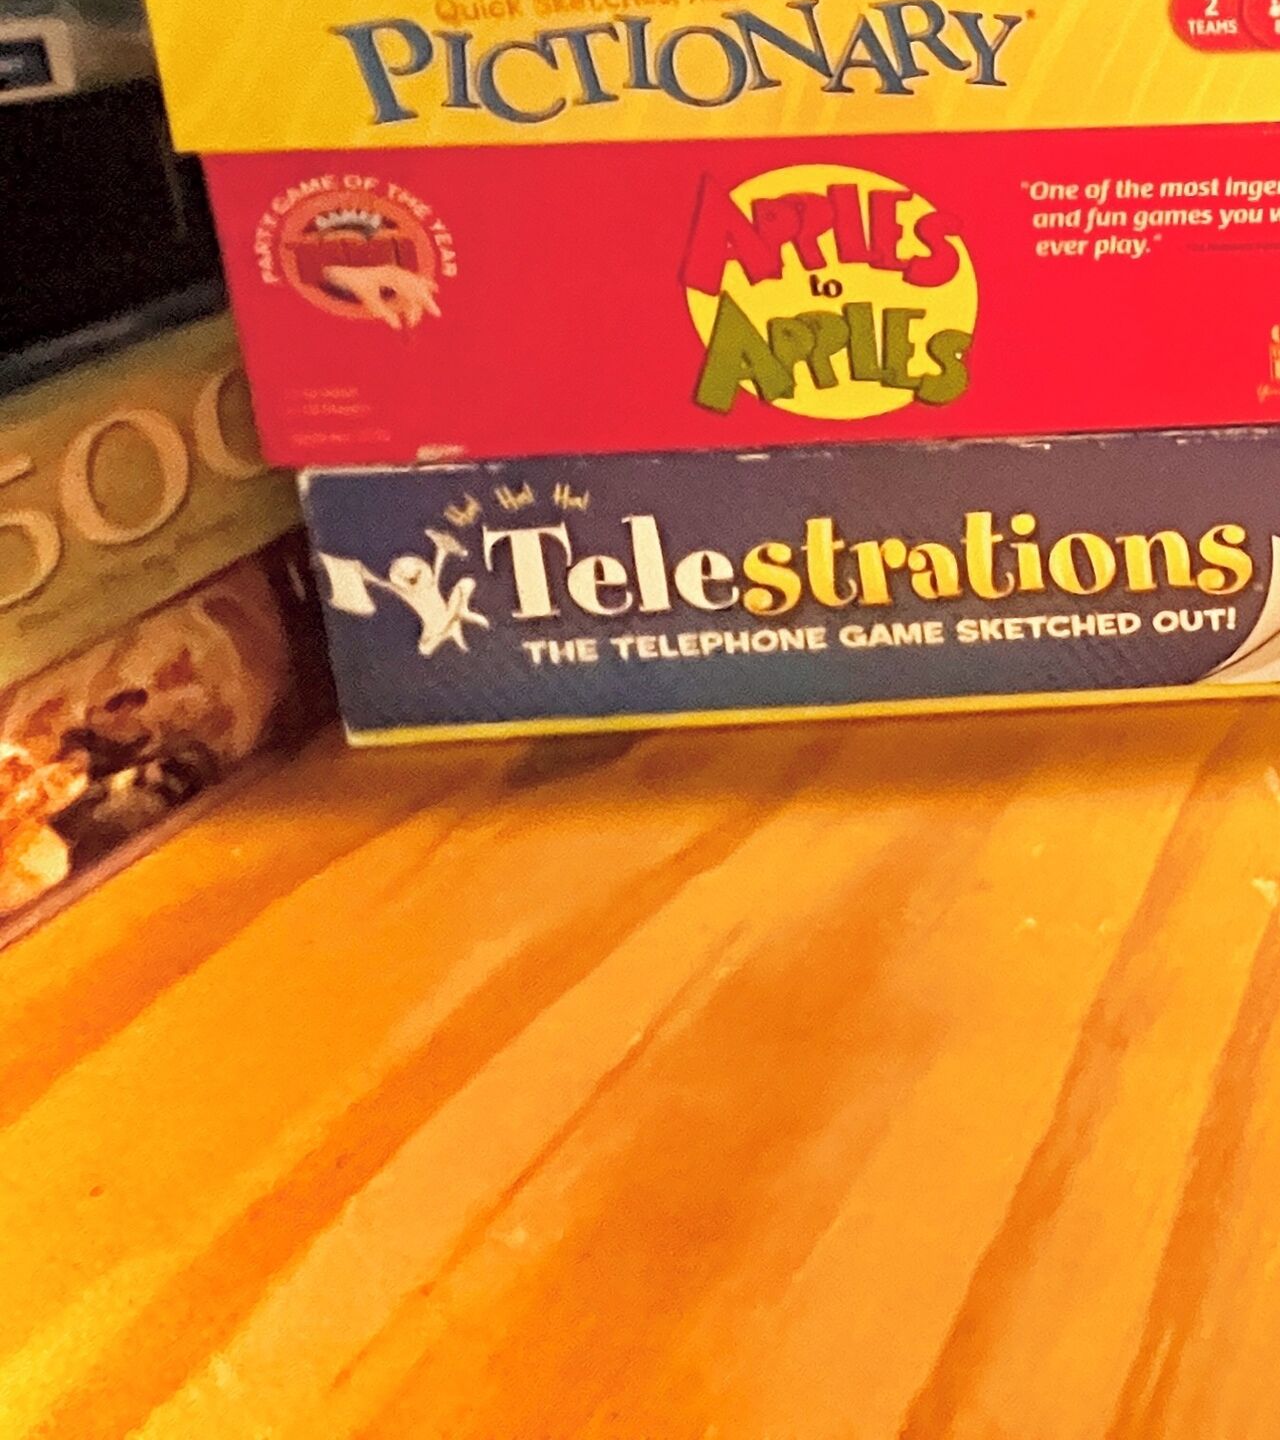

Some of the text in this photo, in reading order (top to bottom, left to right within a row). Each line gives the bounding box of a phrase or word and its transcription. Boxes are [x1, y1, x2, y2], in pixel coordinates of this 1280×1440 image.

[1187, 18, 1238, 36] TEAMS
[1084, 177, 1111, 206] of
[1115, 177, 1154, 199] the
[1159, 177, 1220, 199] most
[254, 173, 459, 284] PARTY GAME OF THE YEAR
[679, 171, 966, 298] APPLES
[1032, 207, 1082, 229] and
[1084, 205, 1127, 235] fun
[1133, 210, 1214, 233] games
[1217, 208, 1264, 231] you
[1034, 237, 1089, 258] ever
[809, 273, 844, 299] to
[693, 289, 974, 417] APPLES
[482, 510, 1255, 622] Telestrations
[521, 607, 1238, 666] THE TELEPHONE GAME SKETCHED OUT!
